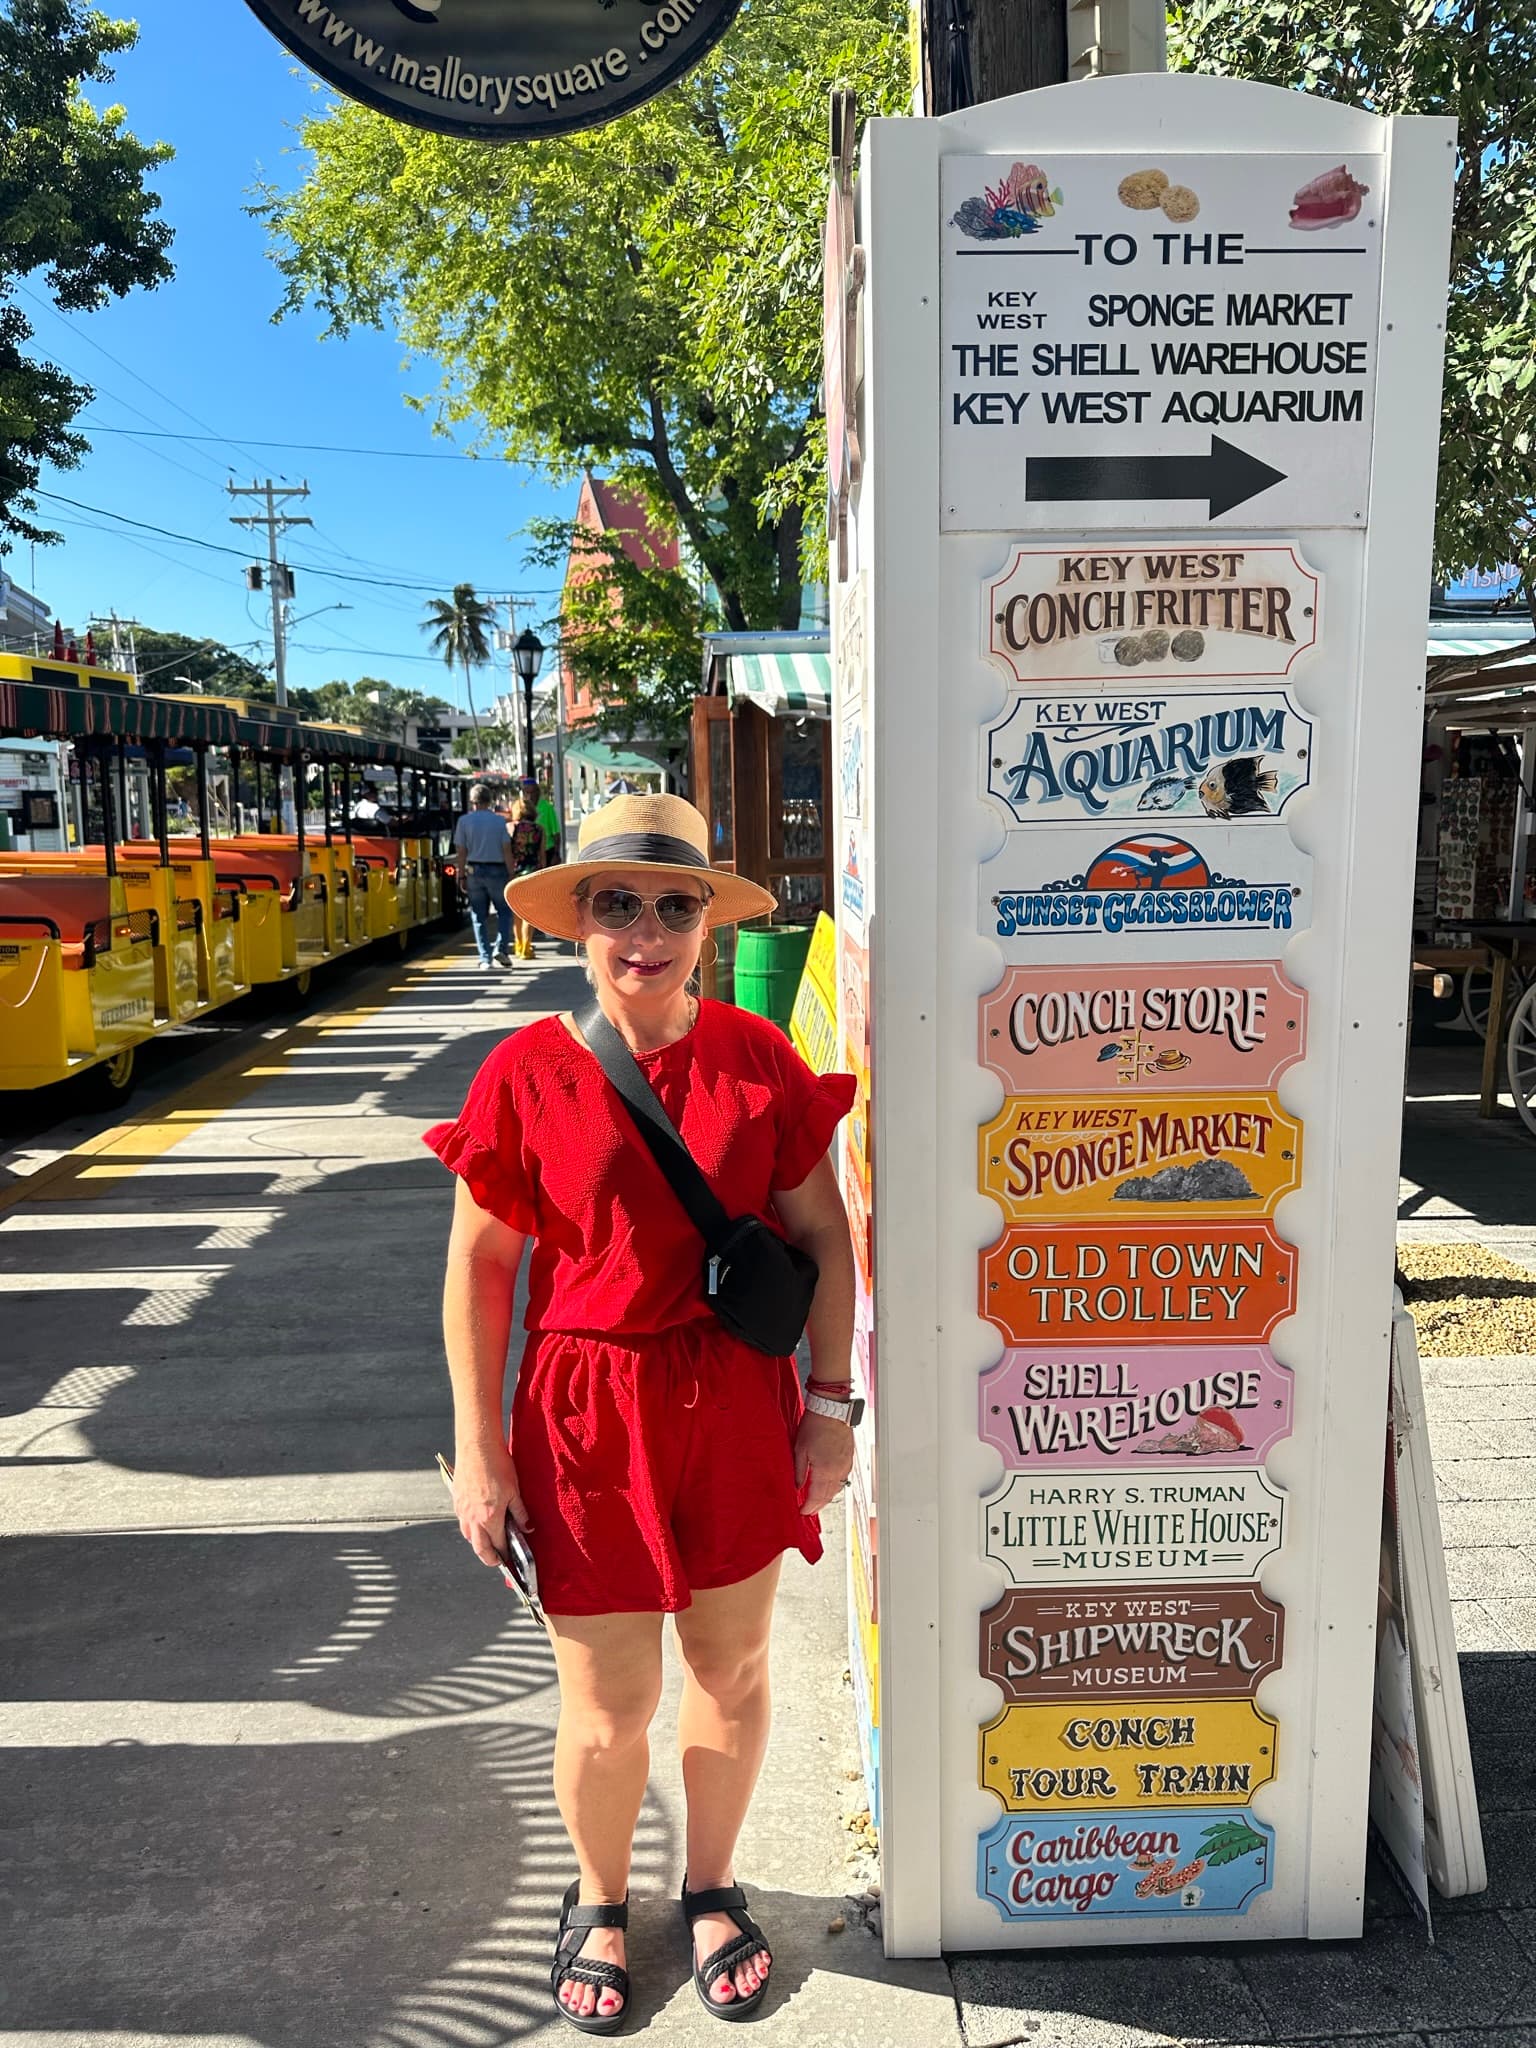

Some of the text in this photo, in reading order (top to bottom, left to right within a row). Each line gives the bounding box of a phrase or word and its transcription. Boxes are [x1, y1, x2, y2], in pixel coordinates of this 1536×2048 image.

[1075, 233, 1244, 266] TO THE
[988, 292, 1038, 308] KEY
[1088, 293, 1352, 327] SPONGE MARKET
[977, 314, 1047, 329] WEST
[952, 342, 1367, 377] THE SHELL WAREHOUSE
[953, 390, 1362, 426] KEY WEST AQUARIUM
[1059, 554, 1244, 584] KEY WEST
[1001, 587, 1297, 654] CONCH FRITTER
[1036, 701, 1167, 723] KEY WEST
[1002, 707, 1287, 815] AQUARIUM
[1009, 987, 1268, 1054] CONCH STORE
[1016, 1109, 1137, 1130] KEY WEST
[1005, 1112, 1272, 1199] SPONGE MARKET
[1008, 1243, 1264, 1280] OLD TOWN
[1030, 1286, 1248, 1323] TROLLEY
[1024, 1364, 1139, 1399] SHELL
[1008, 1369, 1261, 1455] WAREHOUSE
[1030, 1487, 1245, 1504] HARRY S. TRUMAN
[1002, 1508, 1270, 1547] LITTLE WHITE HOUSE
[1063, 1550, 1209, 1569] MUSEUM
[1066, 1600, 1191, 1618] KEY WEST
[1002, 1618, 1261, 1679] SHIPWRECK
[1072, 1666, 1187, 1686] MUSEUM
[1060, 1717, 1195, 1751] CONCH
[1009, 1764, 1251, 1800] TOUR TRAIN
[1008, 1825, 1180, 1866] Caribbean
[1008, 1869, 1119, 1912] Cargo
